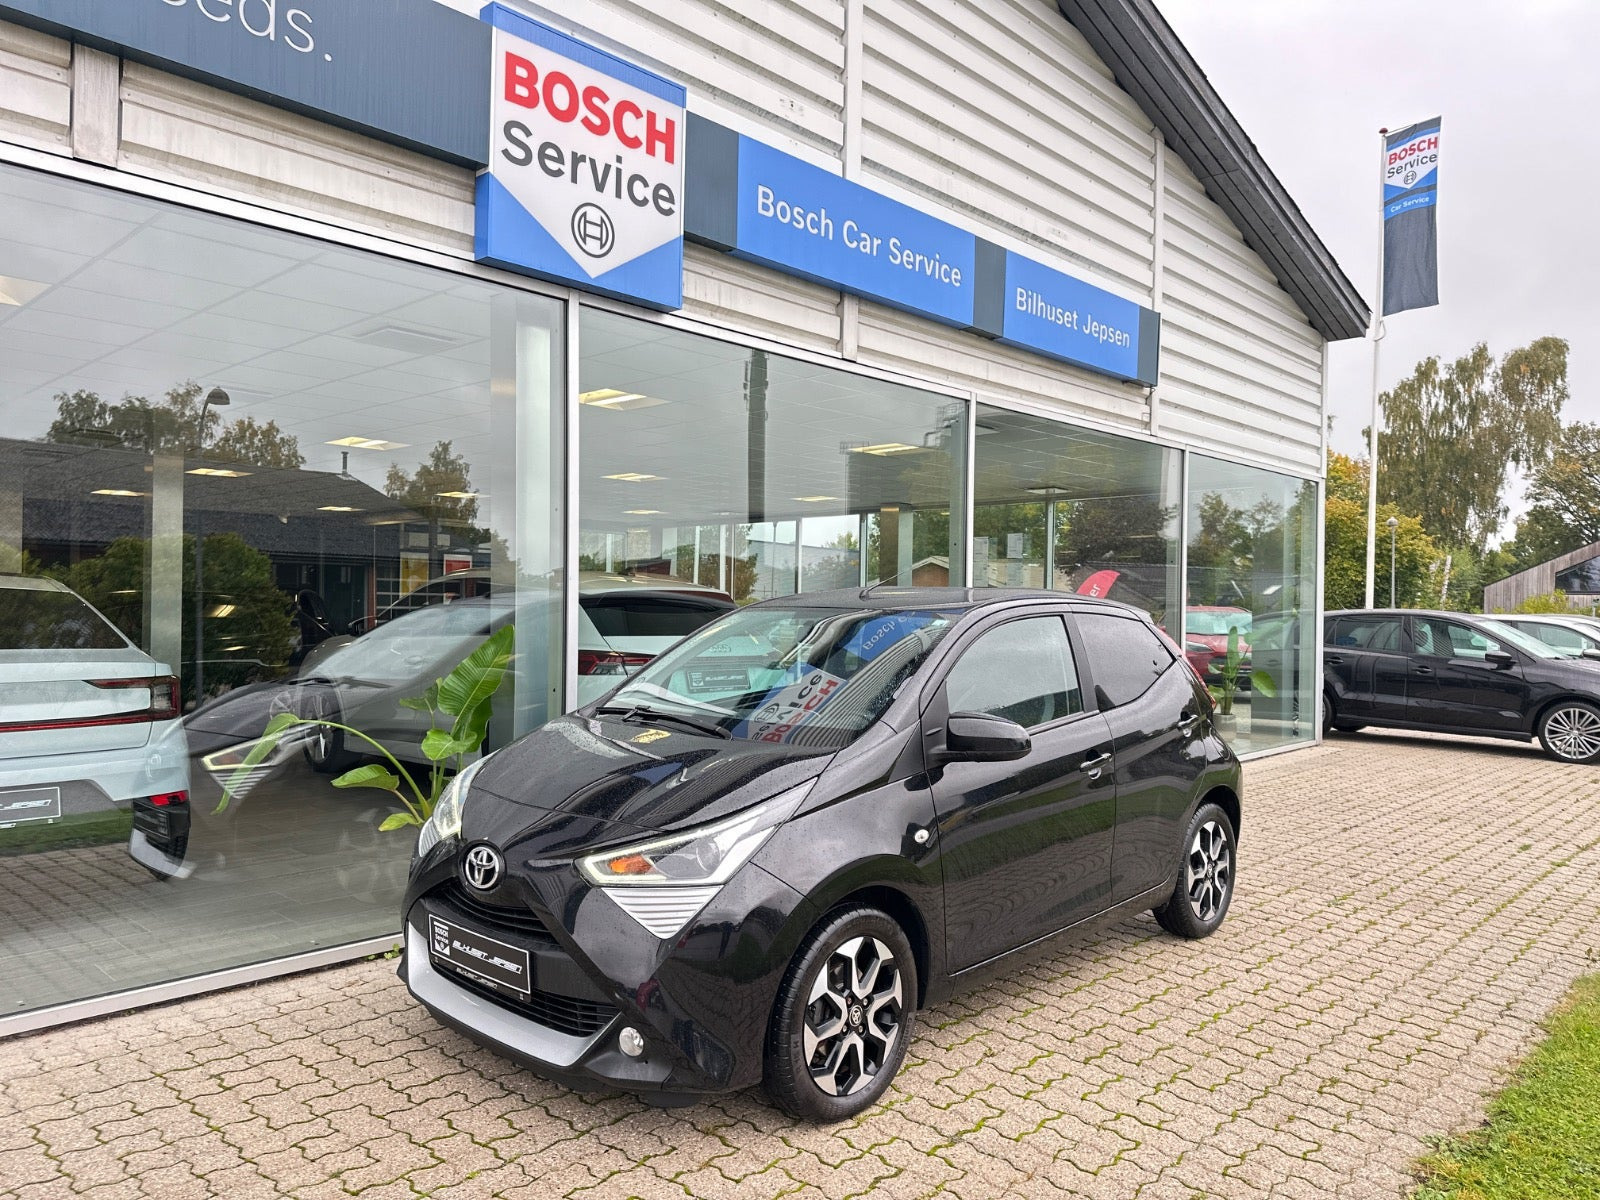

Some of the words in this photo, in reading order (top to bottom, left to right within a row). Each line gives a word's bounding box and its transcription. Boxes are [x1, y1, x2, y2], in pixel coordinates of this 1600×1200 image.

[504, 51, 675, 165] BOSCH
[501, 120, 676, 217] Service
[1387, 153, 1438, 179] Service
[1388, 137, 1438, 166] BOSCH
[757, 184, 834, 241] Bosch
[842, 220, 881, 256] Car
[889, 237, 962, 287] Service
[1016, 287, 1078, 331] Bilhuset
[1082, 314, 1130, 348] Jepsen
